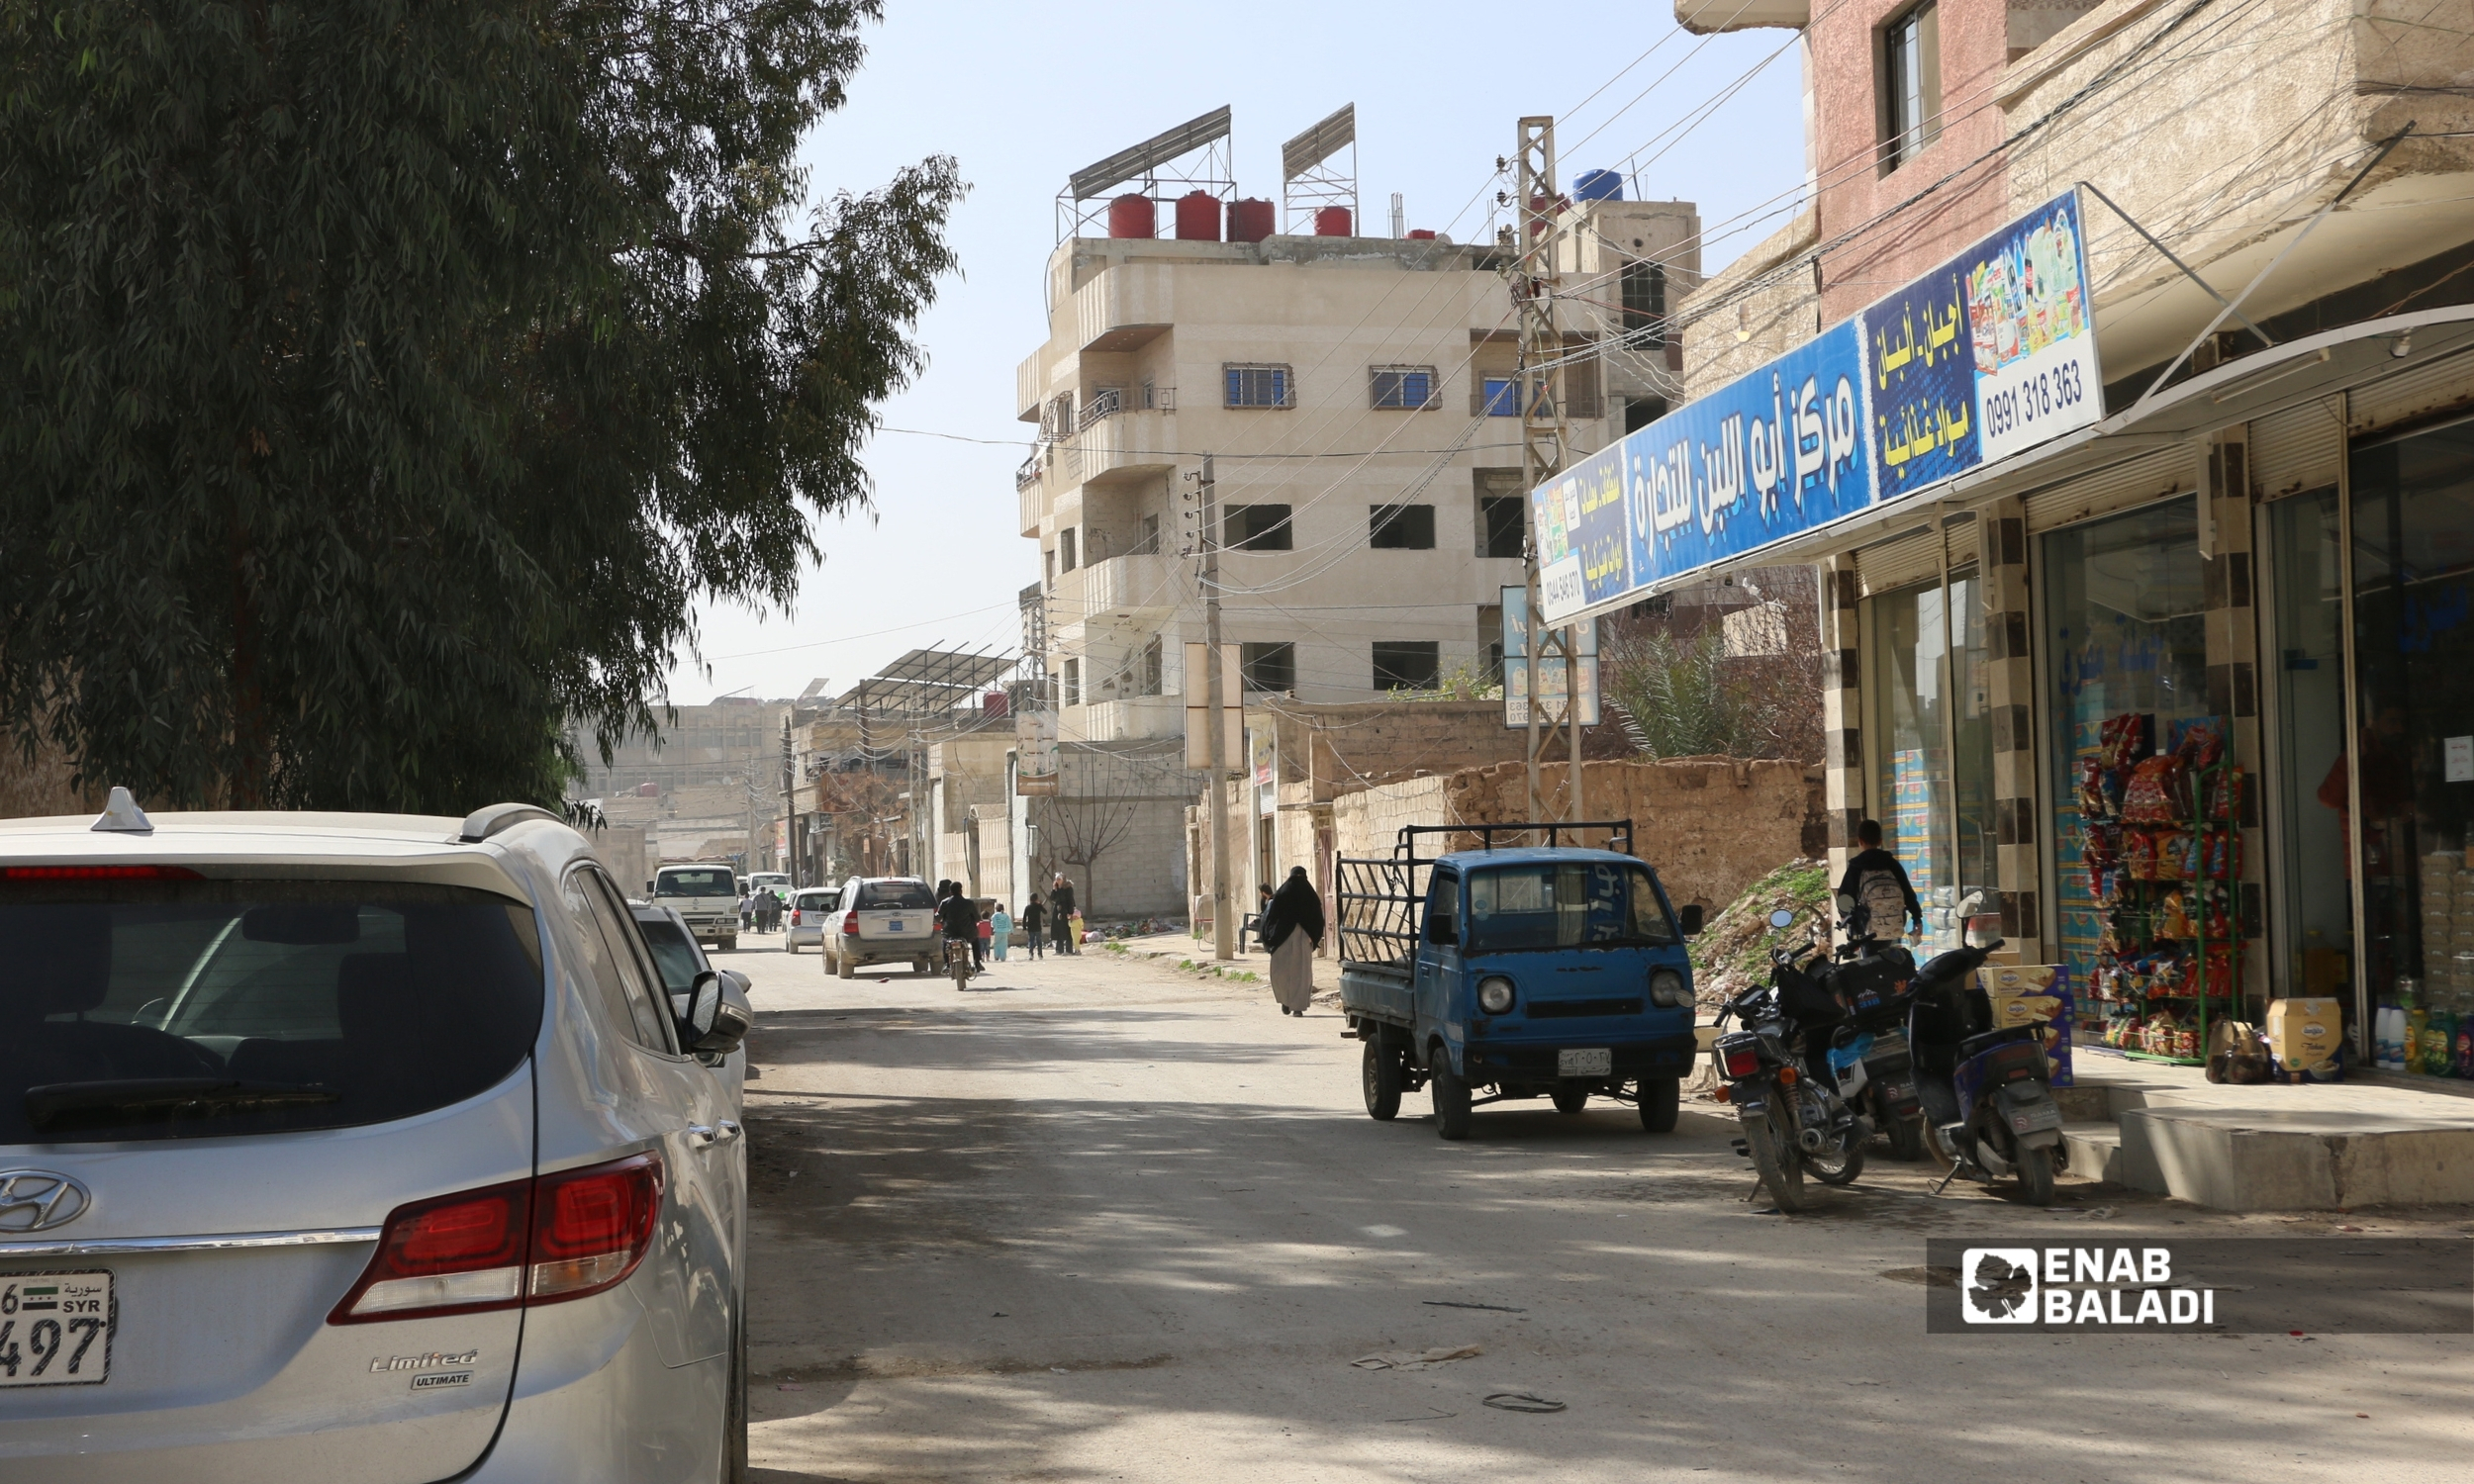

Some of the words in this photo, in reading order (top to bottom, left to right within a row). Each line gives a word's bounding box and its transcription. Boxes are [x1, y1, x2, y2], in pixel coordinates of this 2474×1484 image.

[1876, 301, 1915, 391] ألبان
[1924, 272, 1963, 368] أجبان
[1879, 397, 1936, 480] غذائية
[1937, 396, 1969, 458] مواد
[1986, 386, 2021, 438] 0991
[2023, 373, 2050, 422] 318
[2052, 359, 2082, 410] 363
[1751, 371, 1786, 521] أبو
[1790, 374, 1856, 510] مركز
[1633, 439, 1692, 562] للتجارة
[63, 1300, 100, 1313] SYR
[64, 1283, 102, 1297] سورية
[369, 1349, 479, 1373] Limited
[417, 1374, 470, 1387] ULTIMATE
